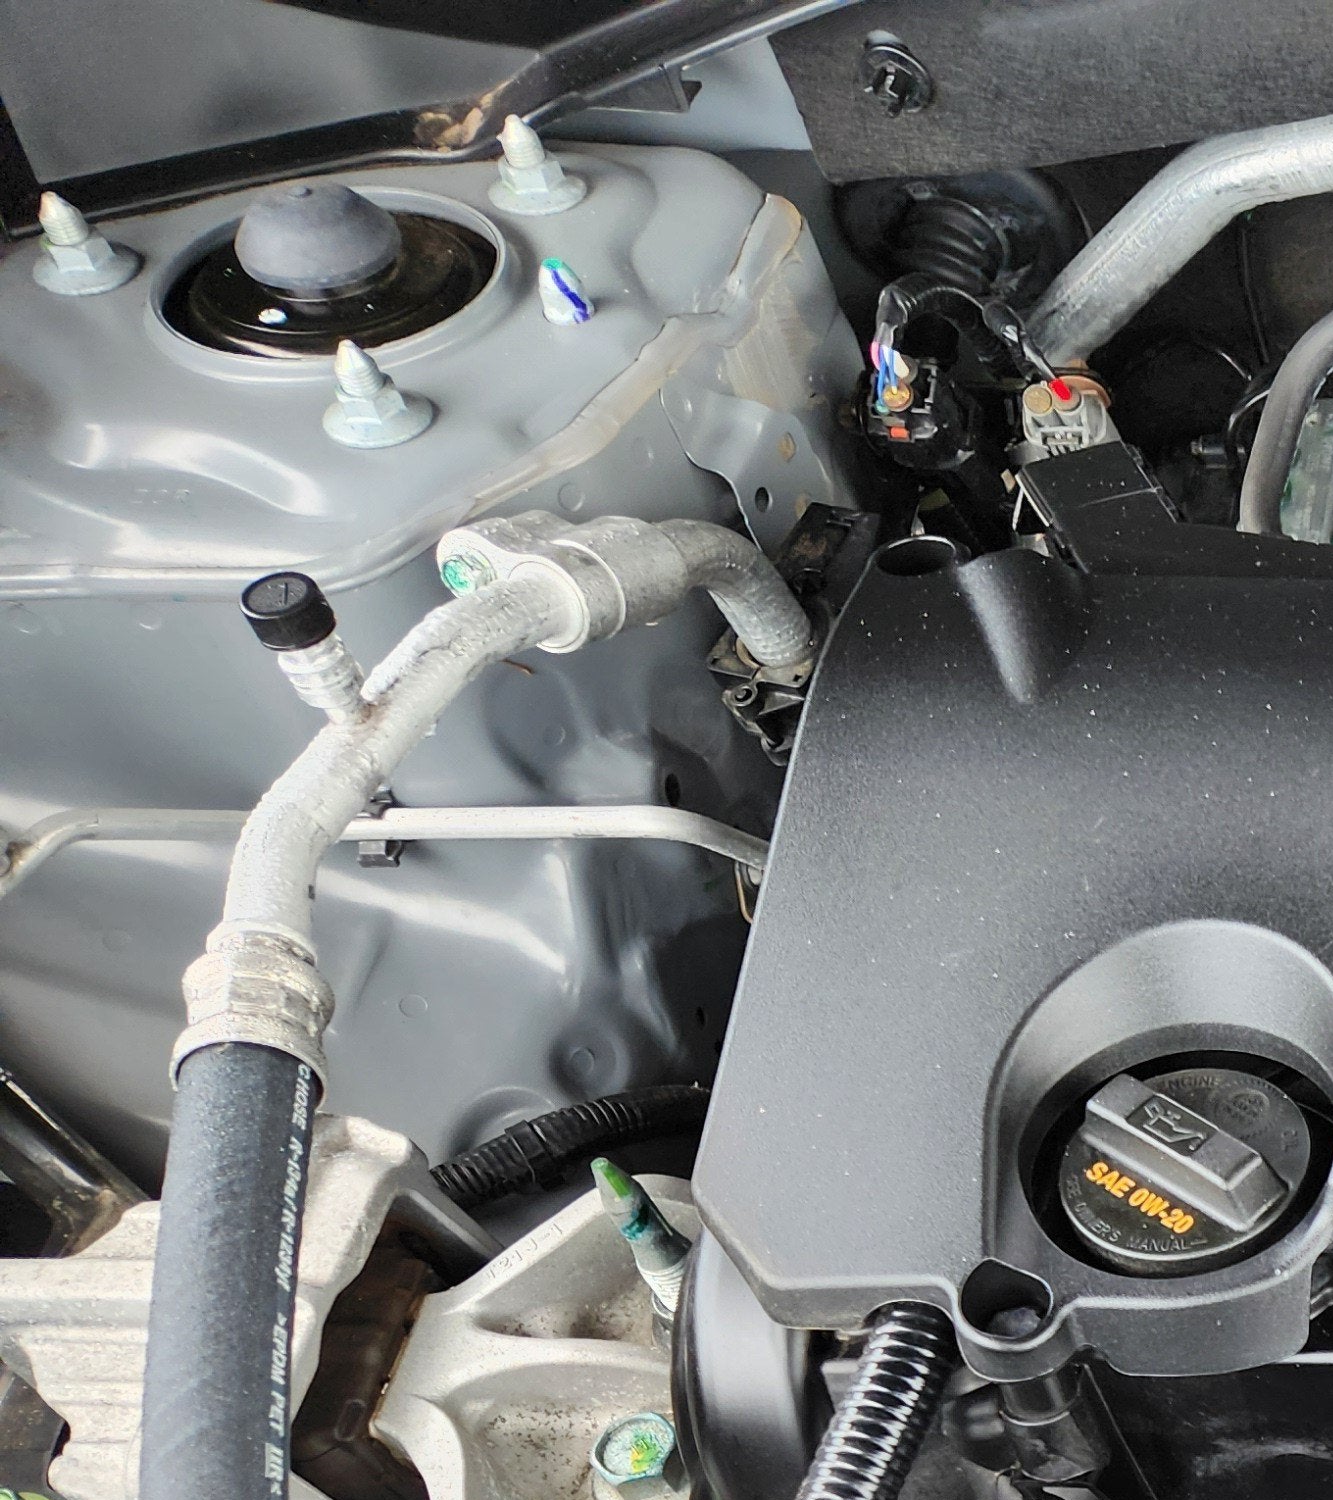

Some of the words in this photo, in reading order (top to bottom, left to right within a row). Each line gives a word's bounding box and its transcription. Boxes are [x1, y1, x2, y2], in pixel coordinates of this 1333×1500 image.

[1084, 1161, 1136, 1199] SAE
[1127, 1187, 1195, 1236] 0W-20
[1126, 1237, 1191, 1253] MANUAL
